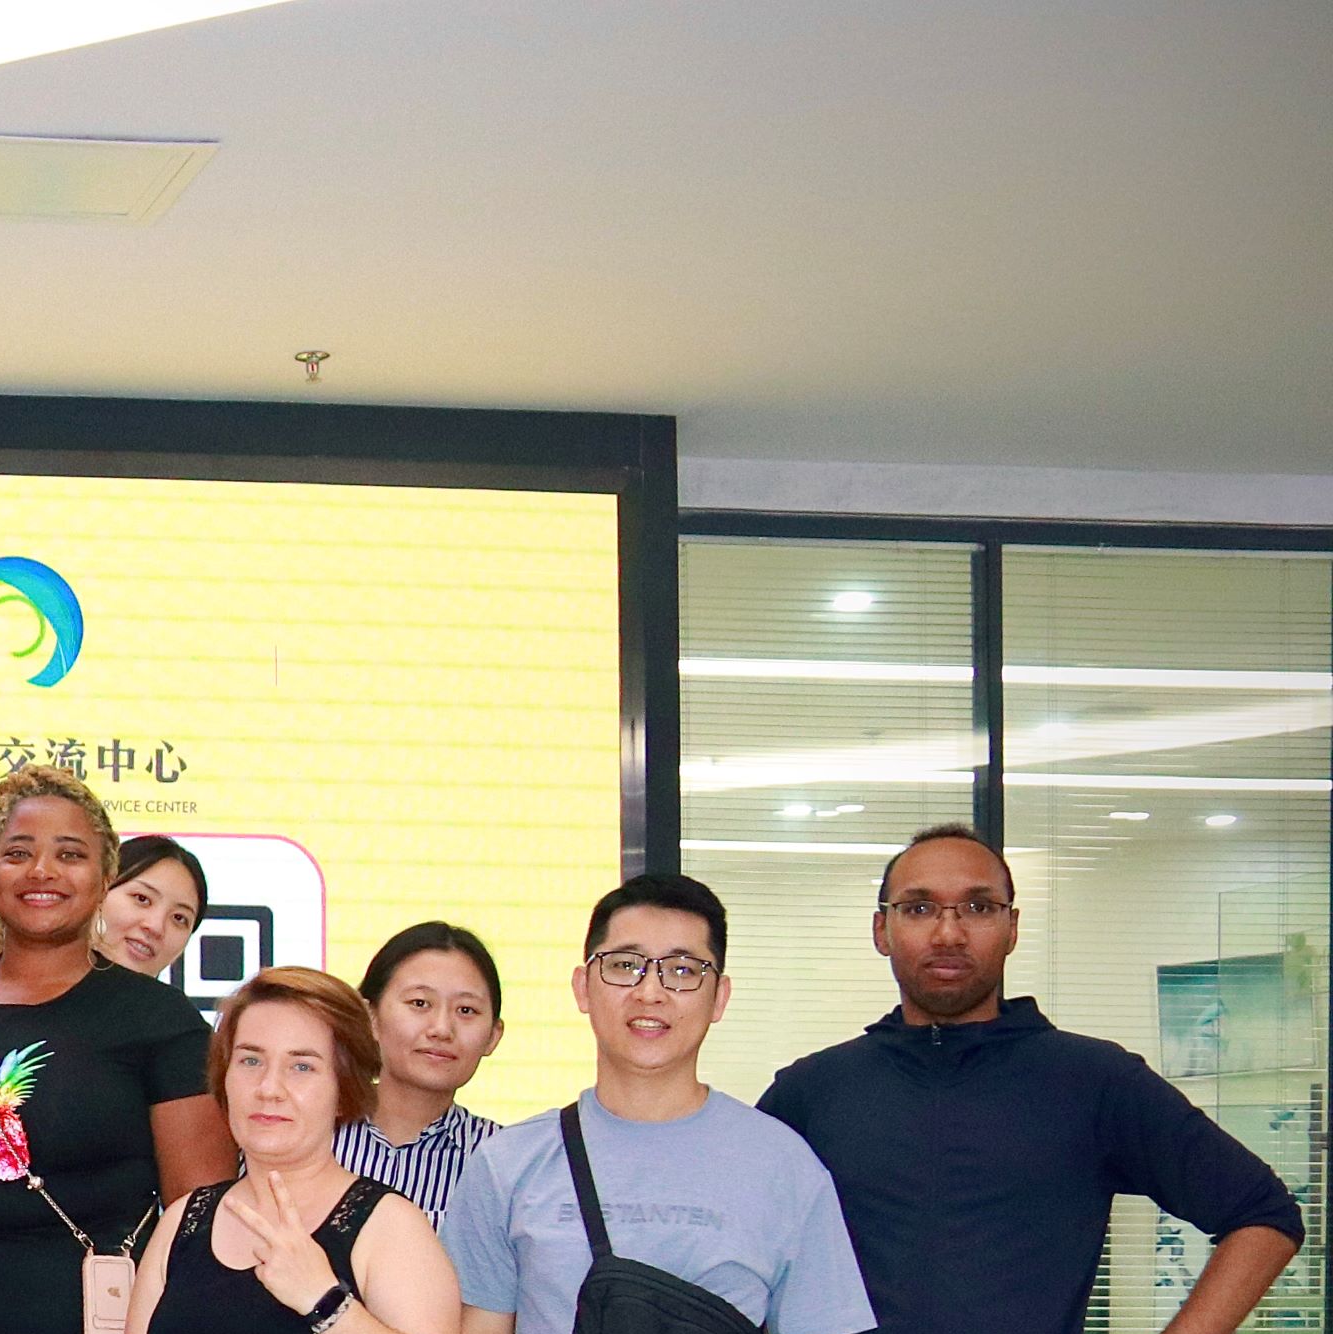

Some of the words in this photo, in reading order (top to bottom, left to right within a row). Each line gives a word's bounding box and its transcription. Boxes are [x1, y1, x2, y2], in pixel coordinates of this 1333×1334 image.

[103, 800, 141, 813] RVICE
[145, 801, 198, 814] CENTER
[558, 1203, 723, 1230] BSTANTEN
